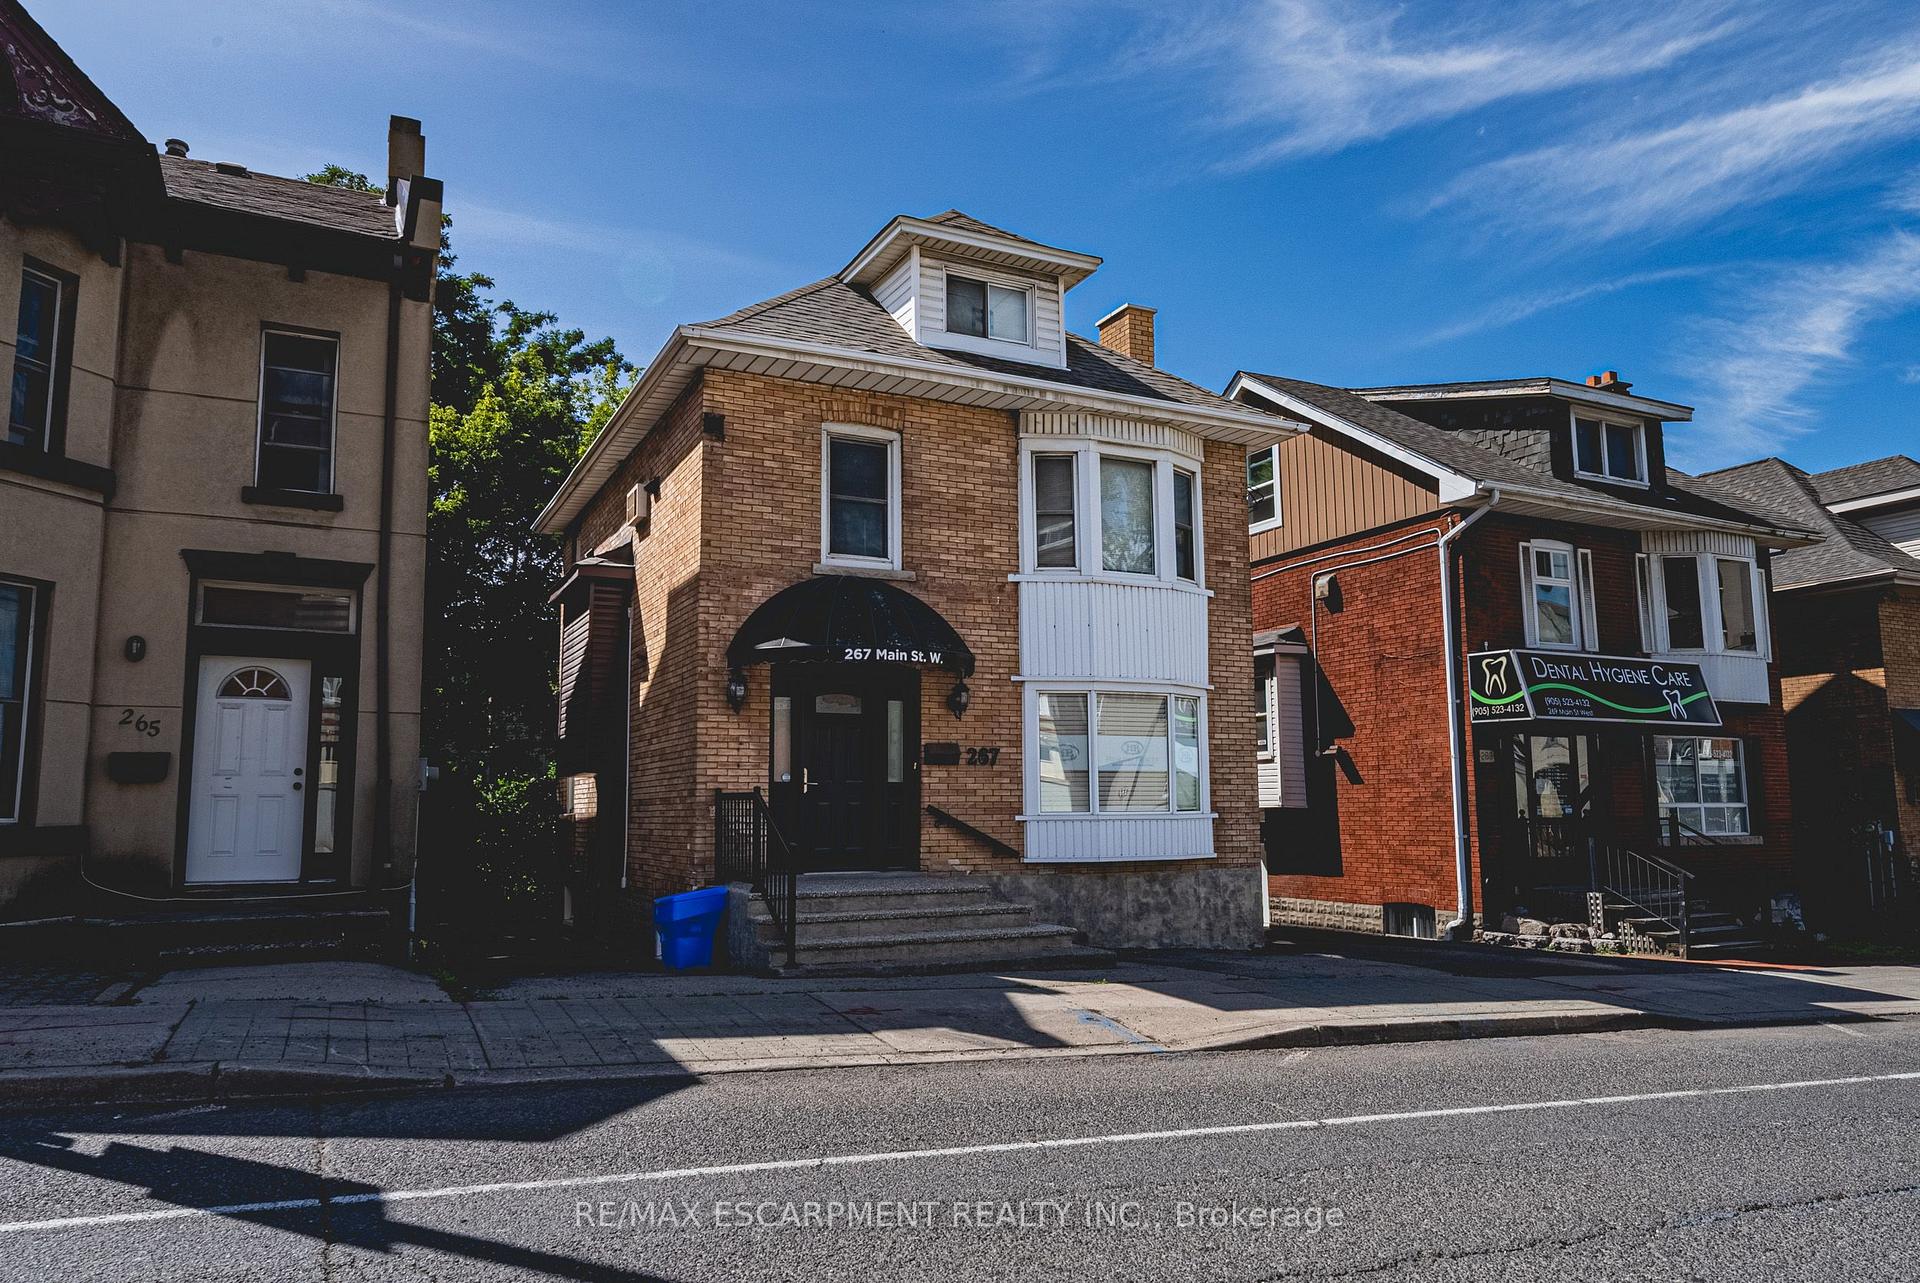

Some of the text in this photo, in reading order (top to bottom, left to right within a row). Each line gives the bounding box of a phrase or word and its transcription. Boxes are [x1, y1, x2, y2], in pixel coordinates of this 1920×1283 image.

[844, 648, 944, 664] 267 Main St. W.
[1651, 665, 1692, 687] CARE
[1545, 696, 1561, 706] (905)
[1472, 703, 1525, 717] (905) 523-4132
[118, 708, 161, 737] 265
[966, 747, 1000, 765] 267
